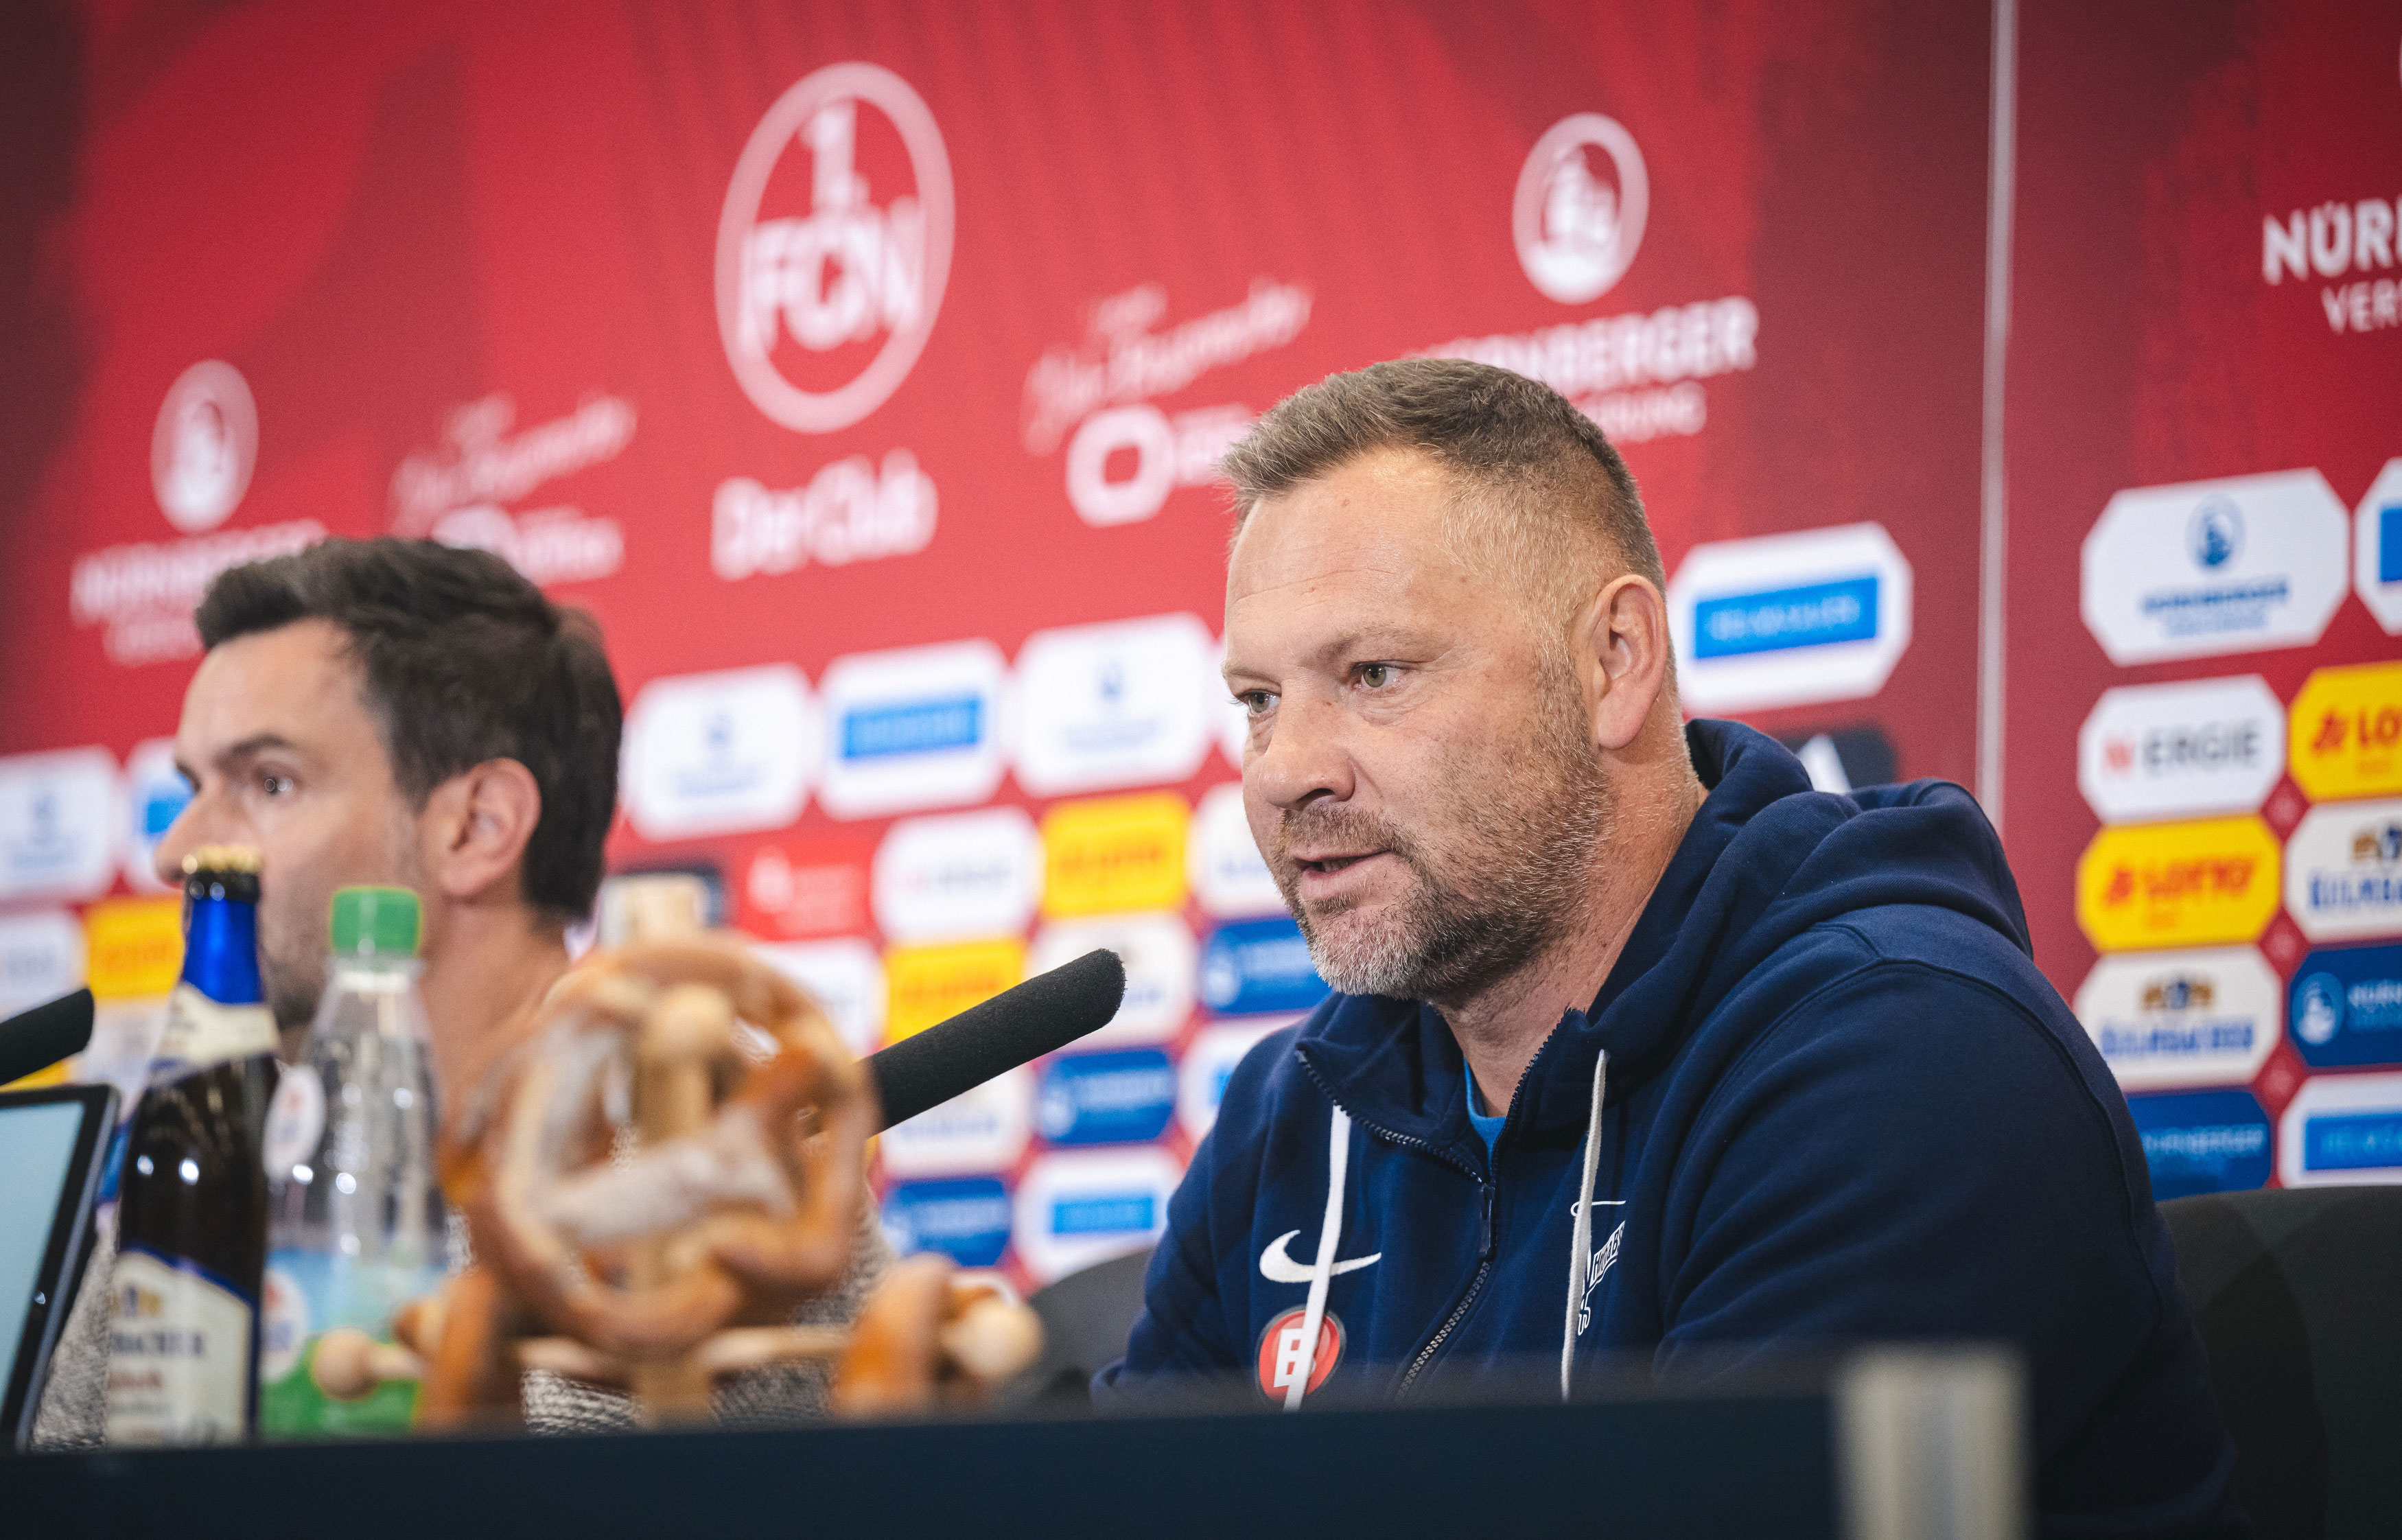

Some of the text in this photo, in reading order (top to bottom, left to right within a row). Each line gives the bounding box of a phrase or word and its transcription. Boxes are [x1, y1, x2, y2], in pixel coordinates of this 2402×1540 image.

[738, 196, 926, 357] FCN
[2263, 194, 2402, 286] NÜR
[2321, 278, 2402, 335] VER
[805, 448, 939, 565] Club
